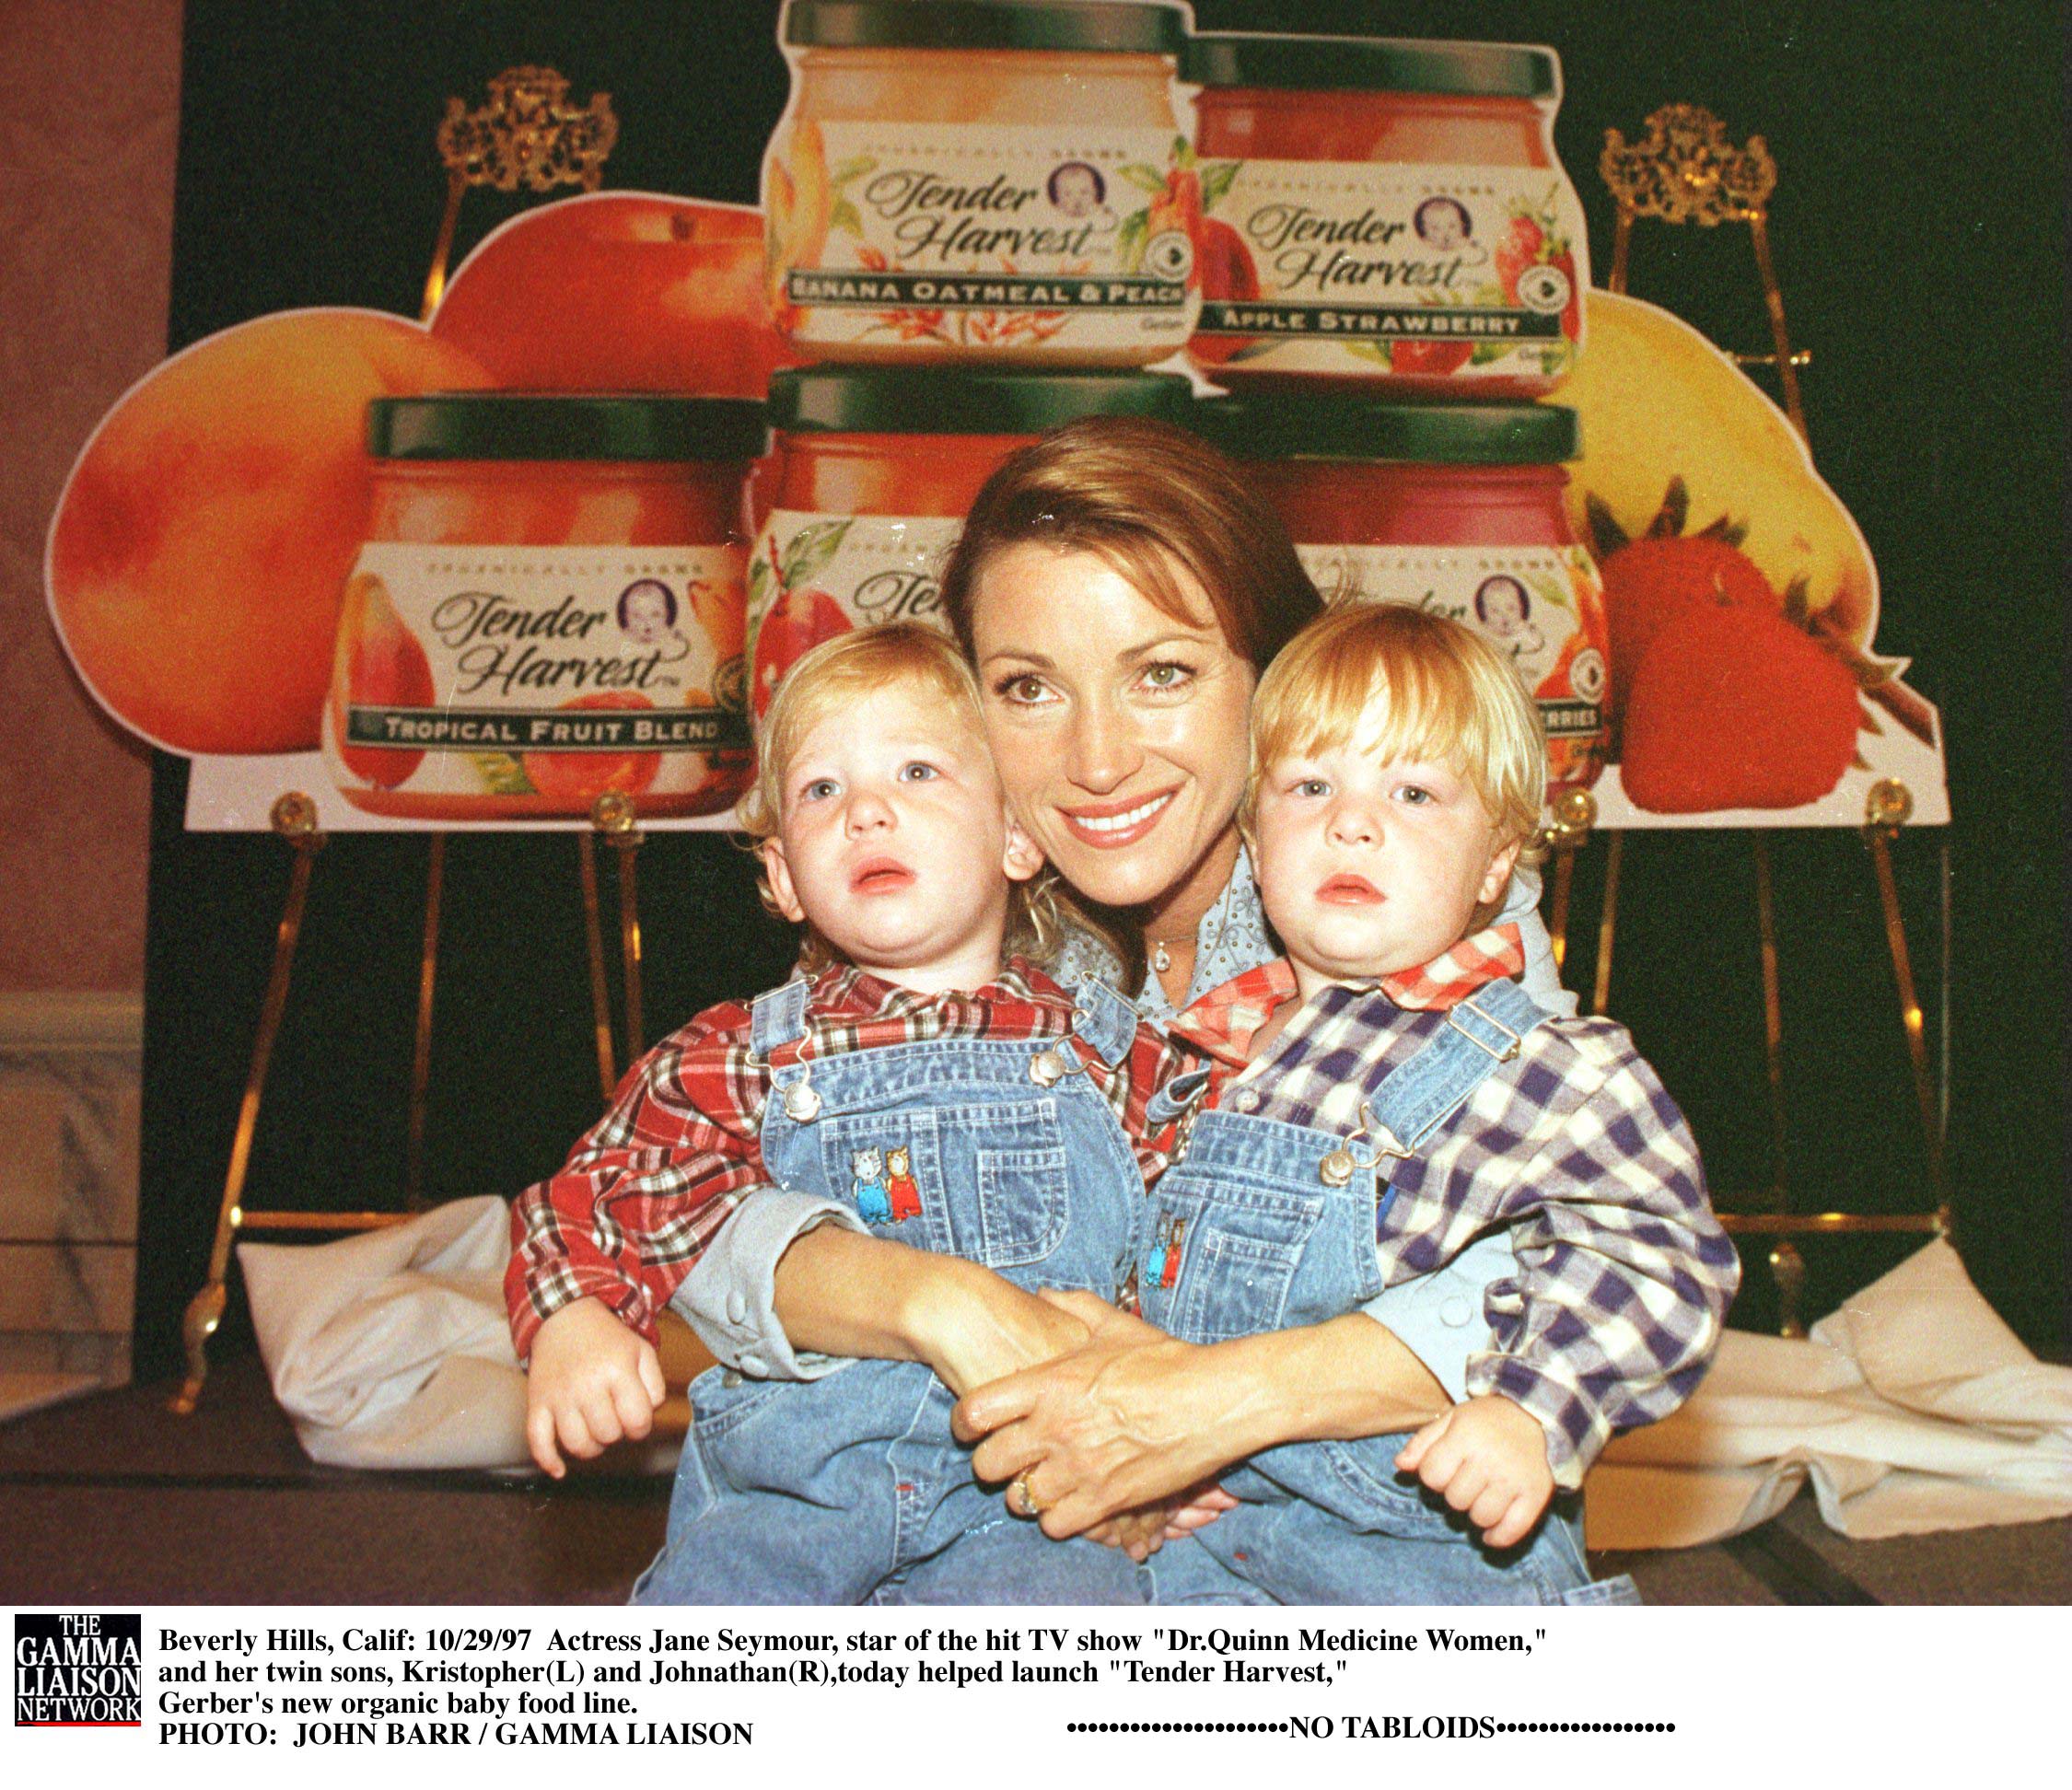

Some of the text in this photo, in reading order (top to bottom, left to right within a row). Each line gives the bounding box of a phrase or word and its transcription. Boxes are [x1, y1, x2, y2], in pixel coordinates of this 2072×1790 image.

[864, 169, 1040, 220] Tender
[893, 214, 1094, 262] Harvest
[1247, 203, 1405, 253] Tender
[792, 277, 899, 300] BANANA
[912, 281, 1071, 303] OATMEAL
[1079, 282, 1101, 304] &
[1275, 249, 1463, 292] Harvest
[1222, 308, 1521, 333] APPLE STRAWBERRY
[430, 591, 608, 651] Tender
[456, 645, 660, 696] Harvest
[385, 715, 716, 743] TROPICAL FRUIT BLEND
[1540, 709, 1598, 727] RRIES
